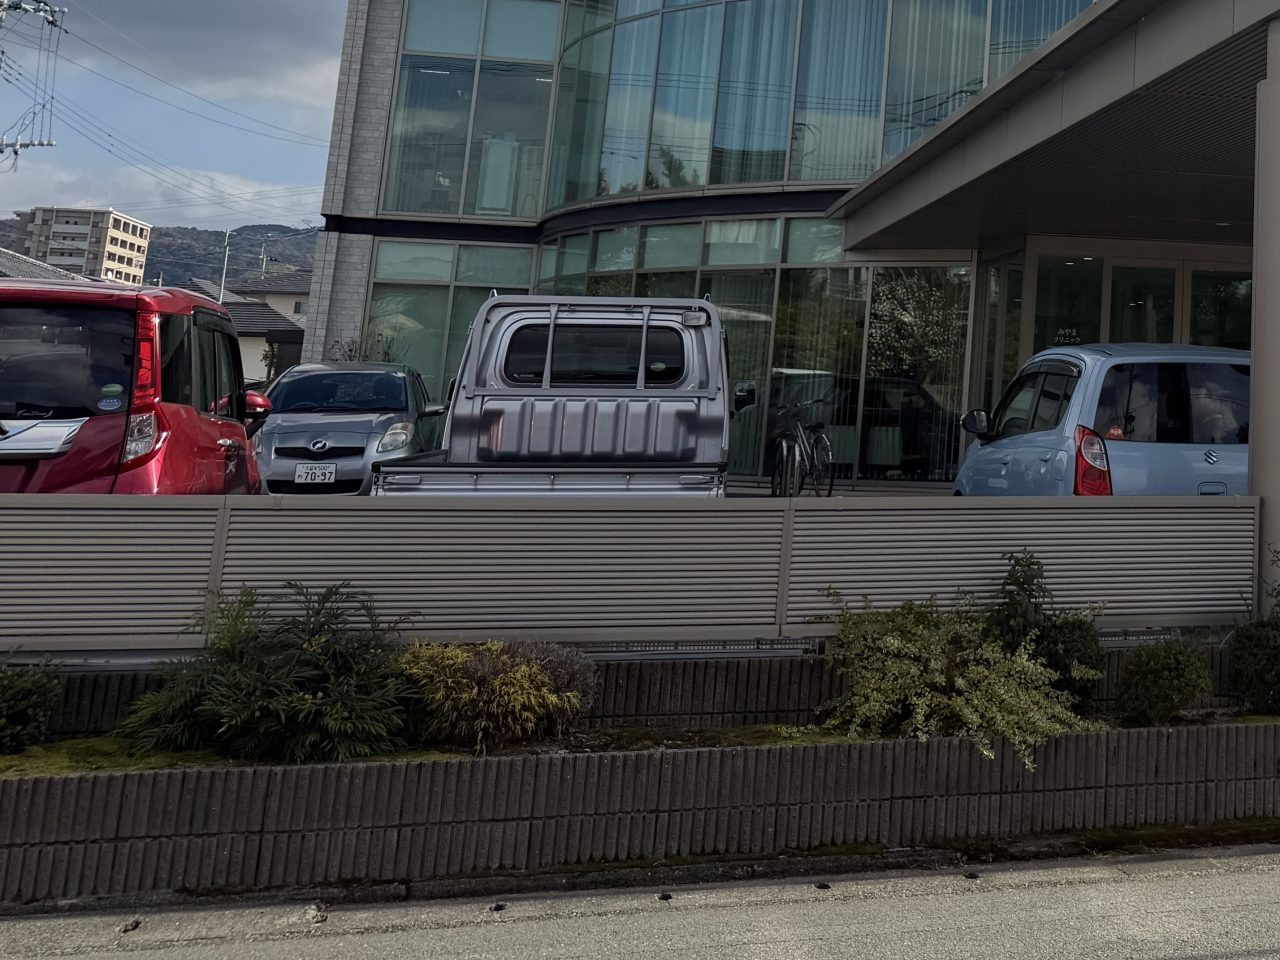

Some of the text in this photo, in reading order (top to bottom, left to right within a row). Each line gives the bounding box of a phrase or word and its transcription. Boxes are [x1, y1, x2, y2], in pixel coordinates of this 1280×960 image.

[1057, 328, 1077, 336] みやま
[1053, 336, 1081, 344] クリニック
[304, 471, 334, 481] 70-97
